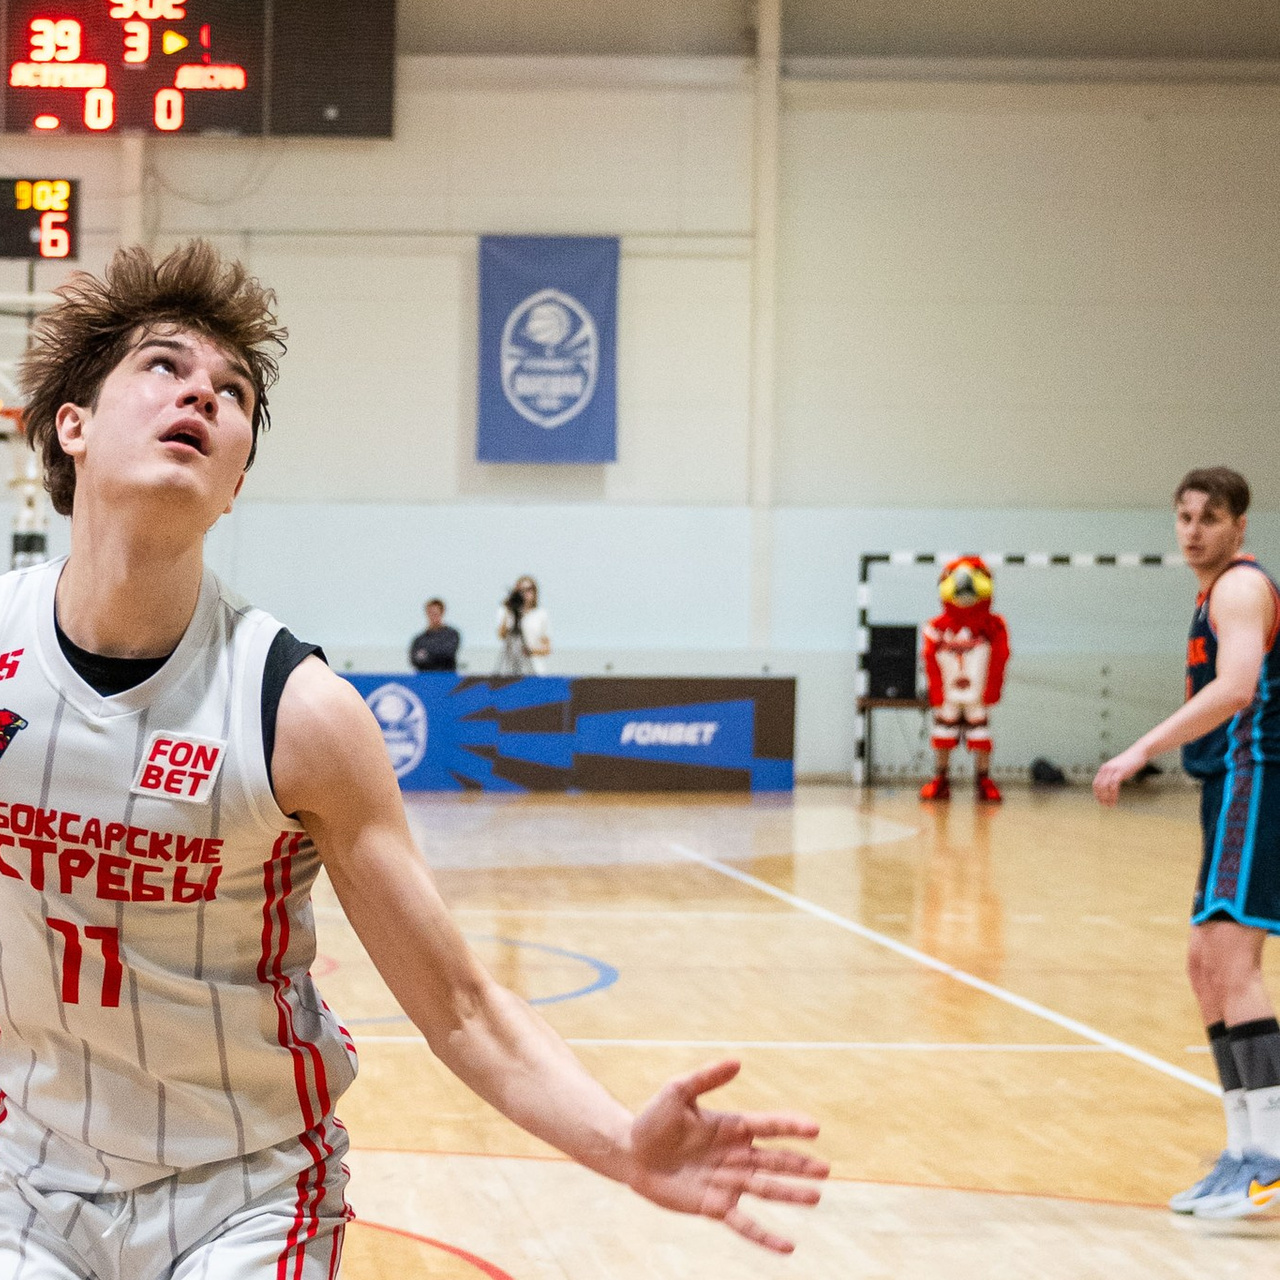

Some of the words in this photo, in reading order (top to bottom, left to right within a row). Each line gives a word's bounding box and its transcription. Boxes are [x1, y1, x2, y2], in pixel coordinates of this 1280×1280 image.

[28, 18, 82, 62] 39
[122, 20, 151, 64] 3
[83, 87, 115, 131] 0
[154, 87, 184, 131] 0
[40, 211, 70, 258] 6
[147, 738, 220, 771] FON
[620, 720, 720, 747] FONBET
[138, 765, 211, 797] BET
